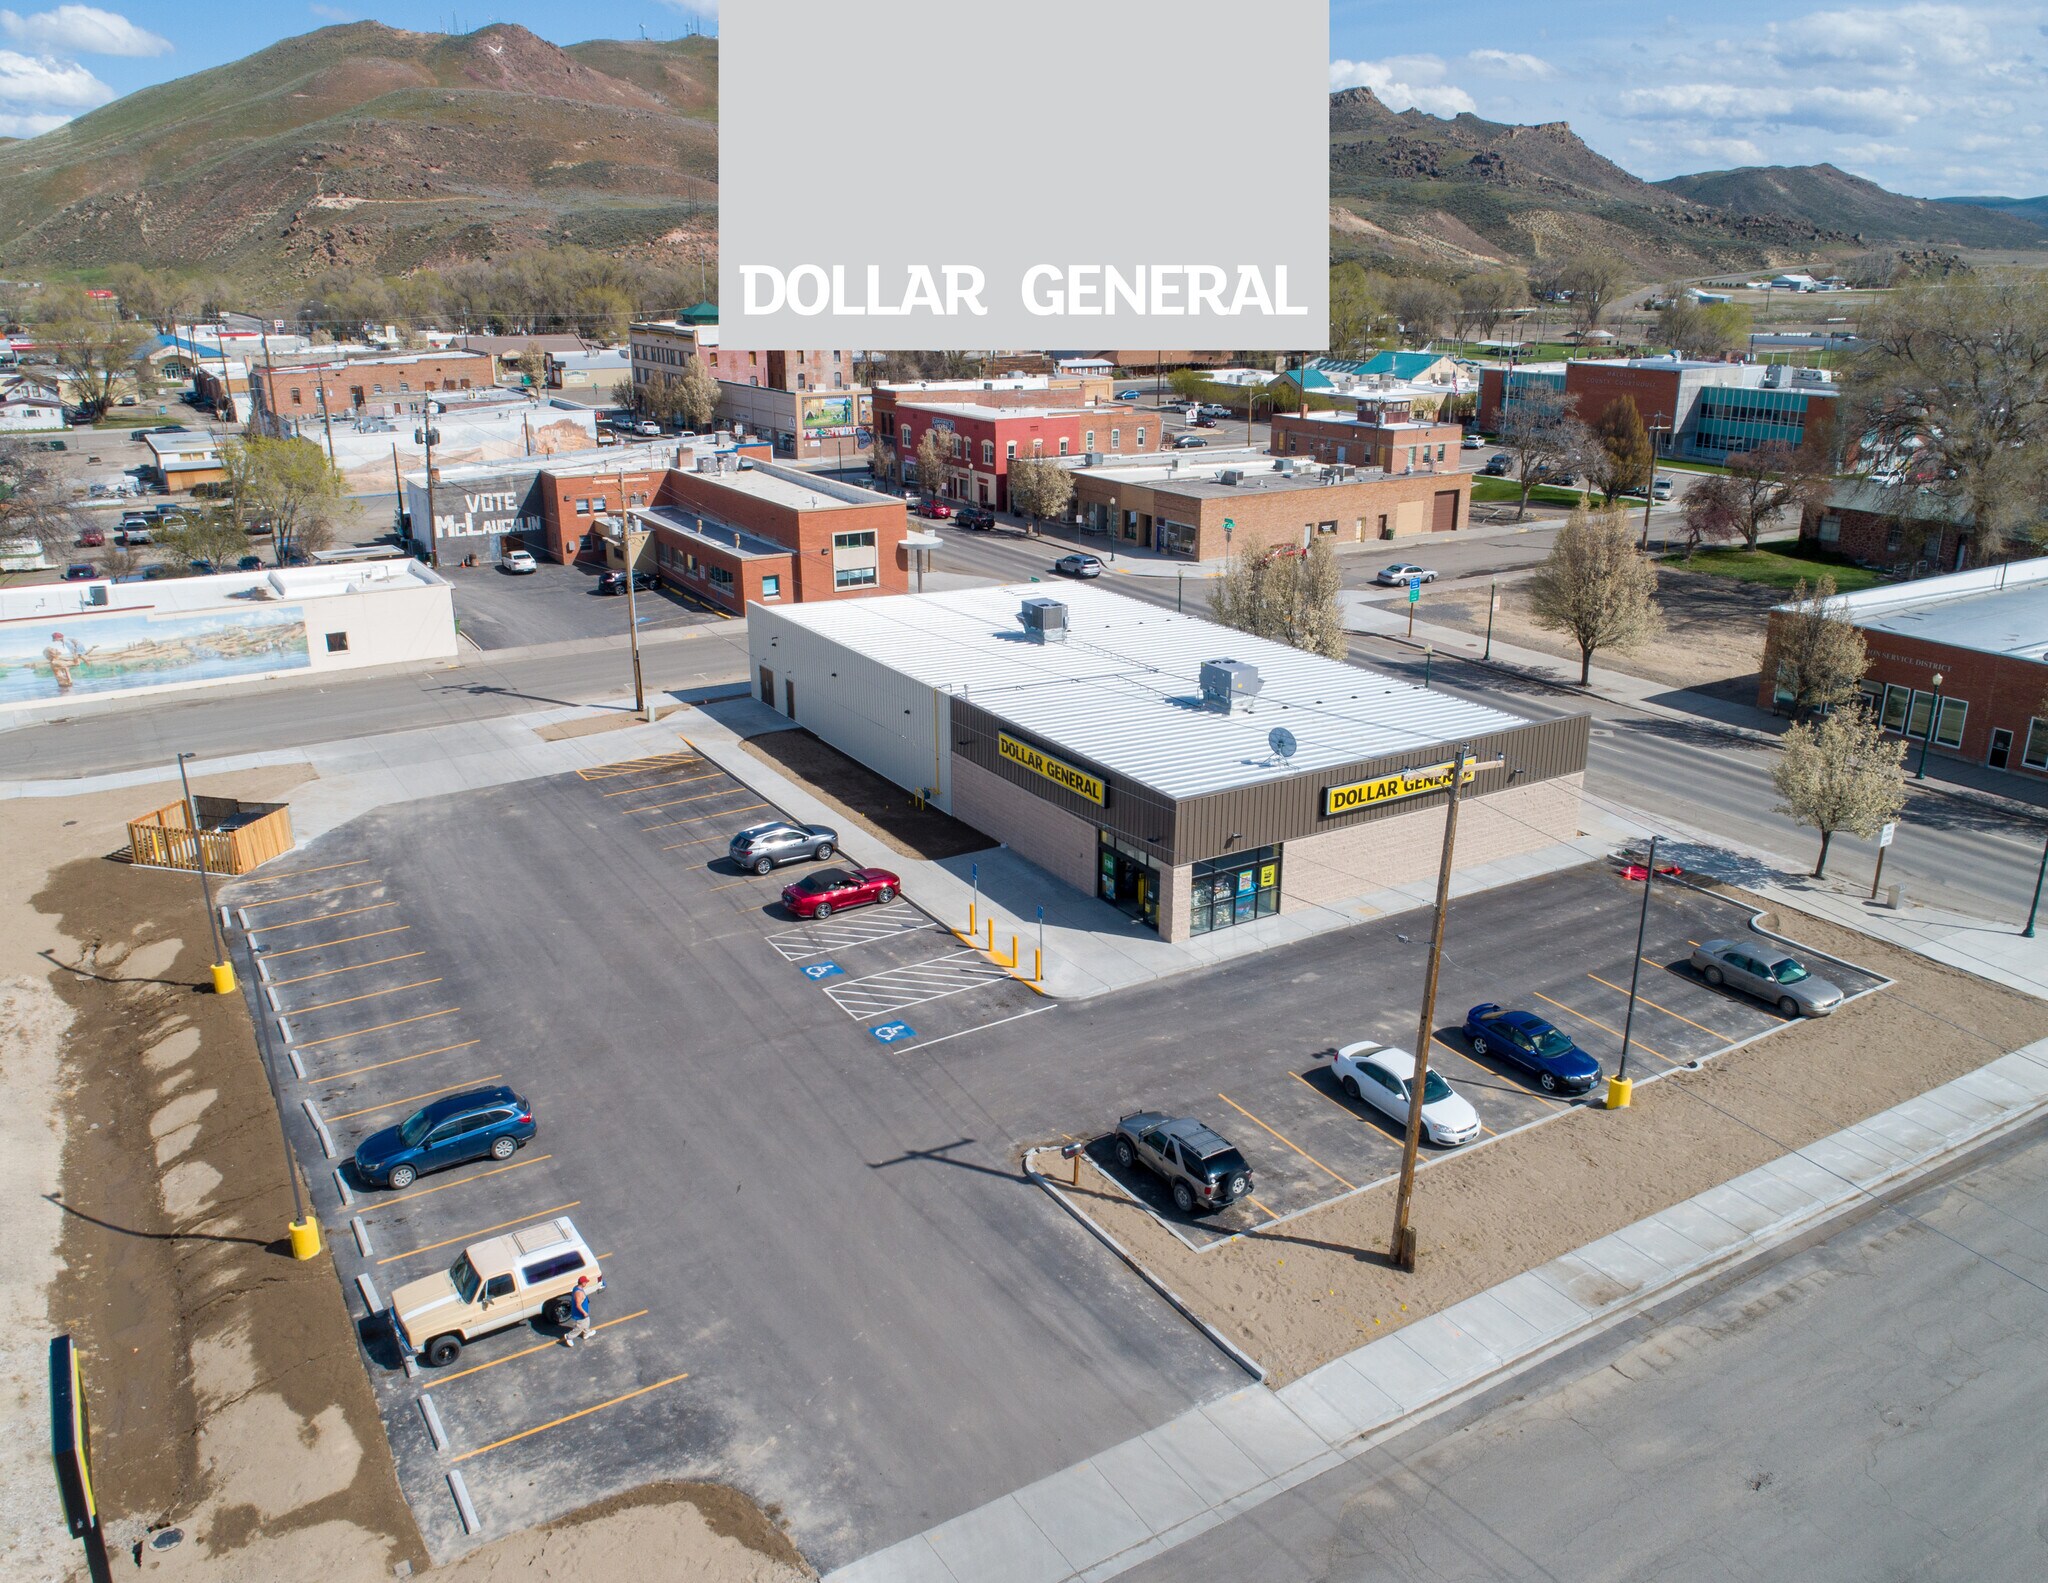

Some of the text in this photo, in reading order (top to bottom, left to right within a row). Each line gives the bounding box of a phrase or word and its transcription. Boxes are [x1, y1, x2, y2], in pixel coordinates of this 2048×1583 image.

[464, 492, 518, 513] VOTE
[1881, 652, 1914, 664] SERVICE
[1915, 659, 1953, 672] DISTRICT
[1000, 738, 1100, 799] DOLLAR GENERAL
[1334, 780, 1398, 808] DOLLAR
